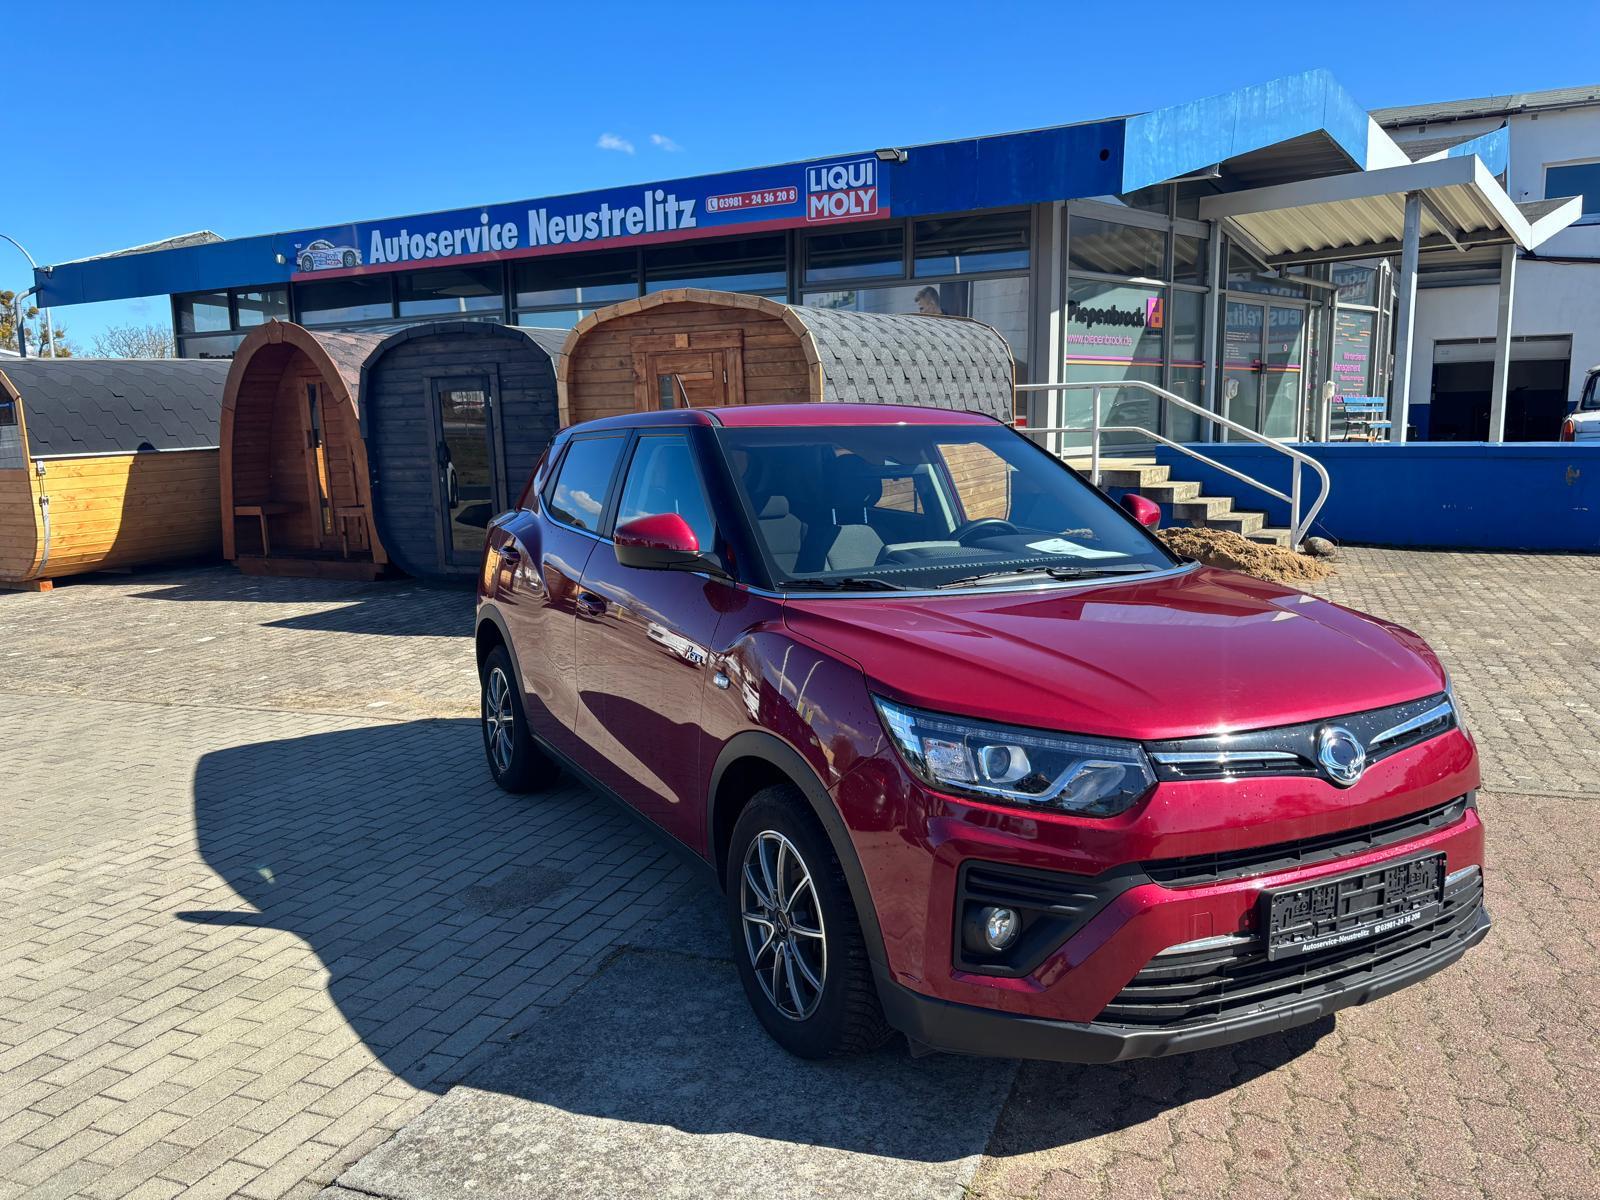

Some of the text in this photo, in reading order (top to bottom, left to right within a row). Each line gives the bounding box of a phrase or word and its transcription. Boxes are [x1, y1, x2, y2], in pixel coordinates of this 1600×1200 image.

[810, 162, 873, 192] LIQUI
[719, 196, 742, 209] 03981
[751, 194, 762, 205] 24
[763, 192, 774, 204] 36
[776, 191, 787, 202] 20
[789, 190, 796, 200] 8
[810, 189, 876, 218] MOLY
[369, 189, 697, 265] Autoservice Neustrelitz
[1302, 930, 1370, 951] Autoservice-Neustrelitz
